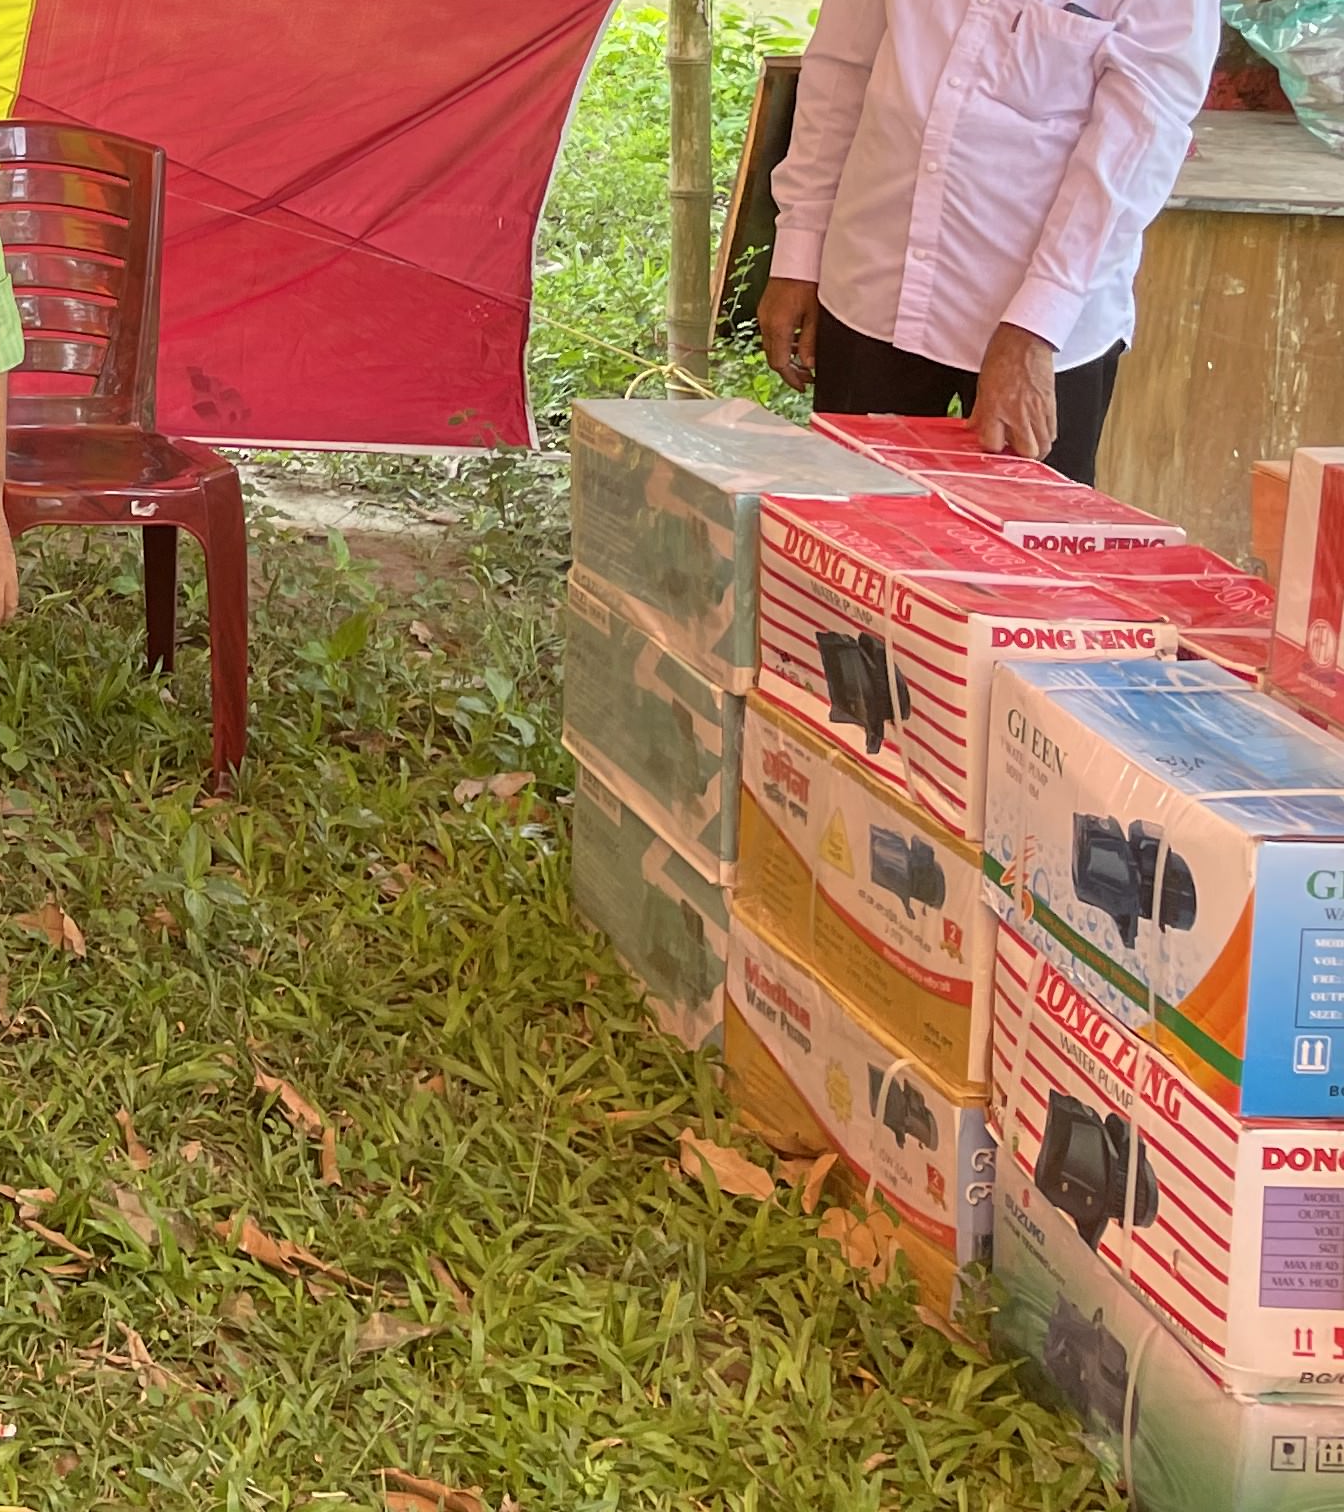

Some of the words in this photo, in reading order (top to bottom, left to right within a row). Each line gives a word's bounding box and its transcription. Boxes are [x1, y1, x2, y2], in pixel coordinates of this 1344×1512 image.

[1023, 534, 1097, 554] DONG
[1103, 537, 1167, 551] FENG
[783, 522, 846, 586] DONG
[848, 555, 913, 625] FENG
[991, 626, 1076, 651] DONG
[1083, 627, 1156, 651] FENG
[1059, 1030, 1097, 1076] WATER
[1096, 1065, 1135, 1110] PUMP
